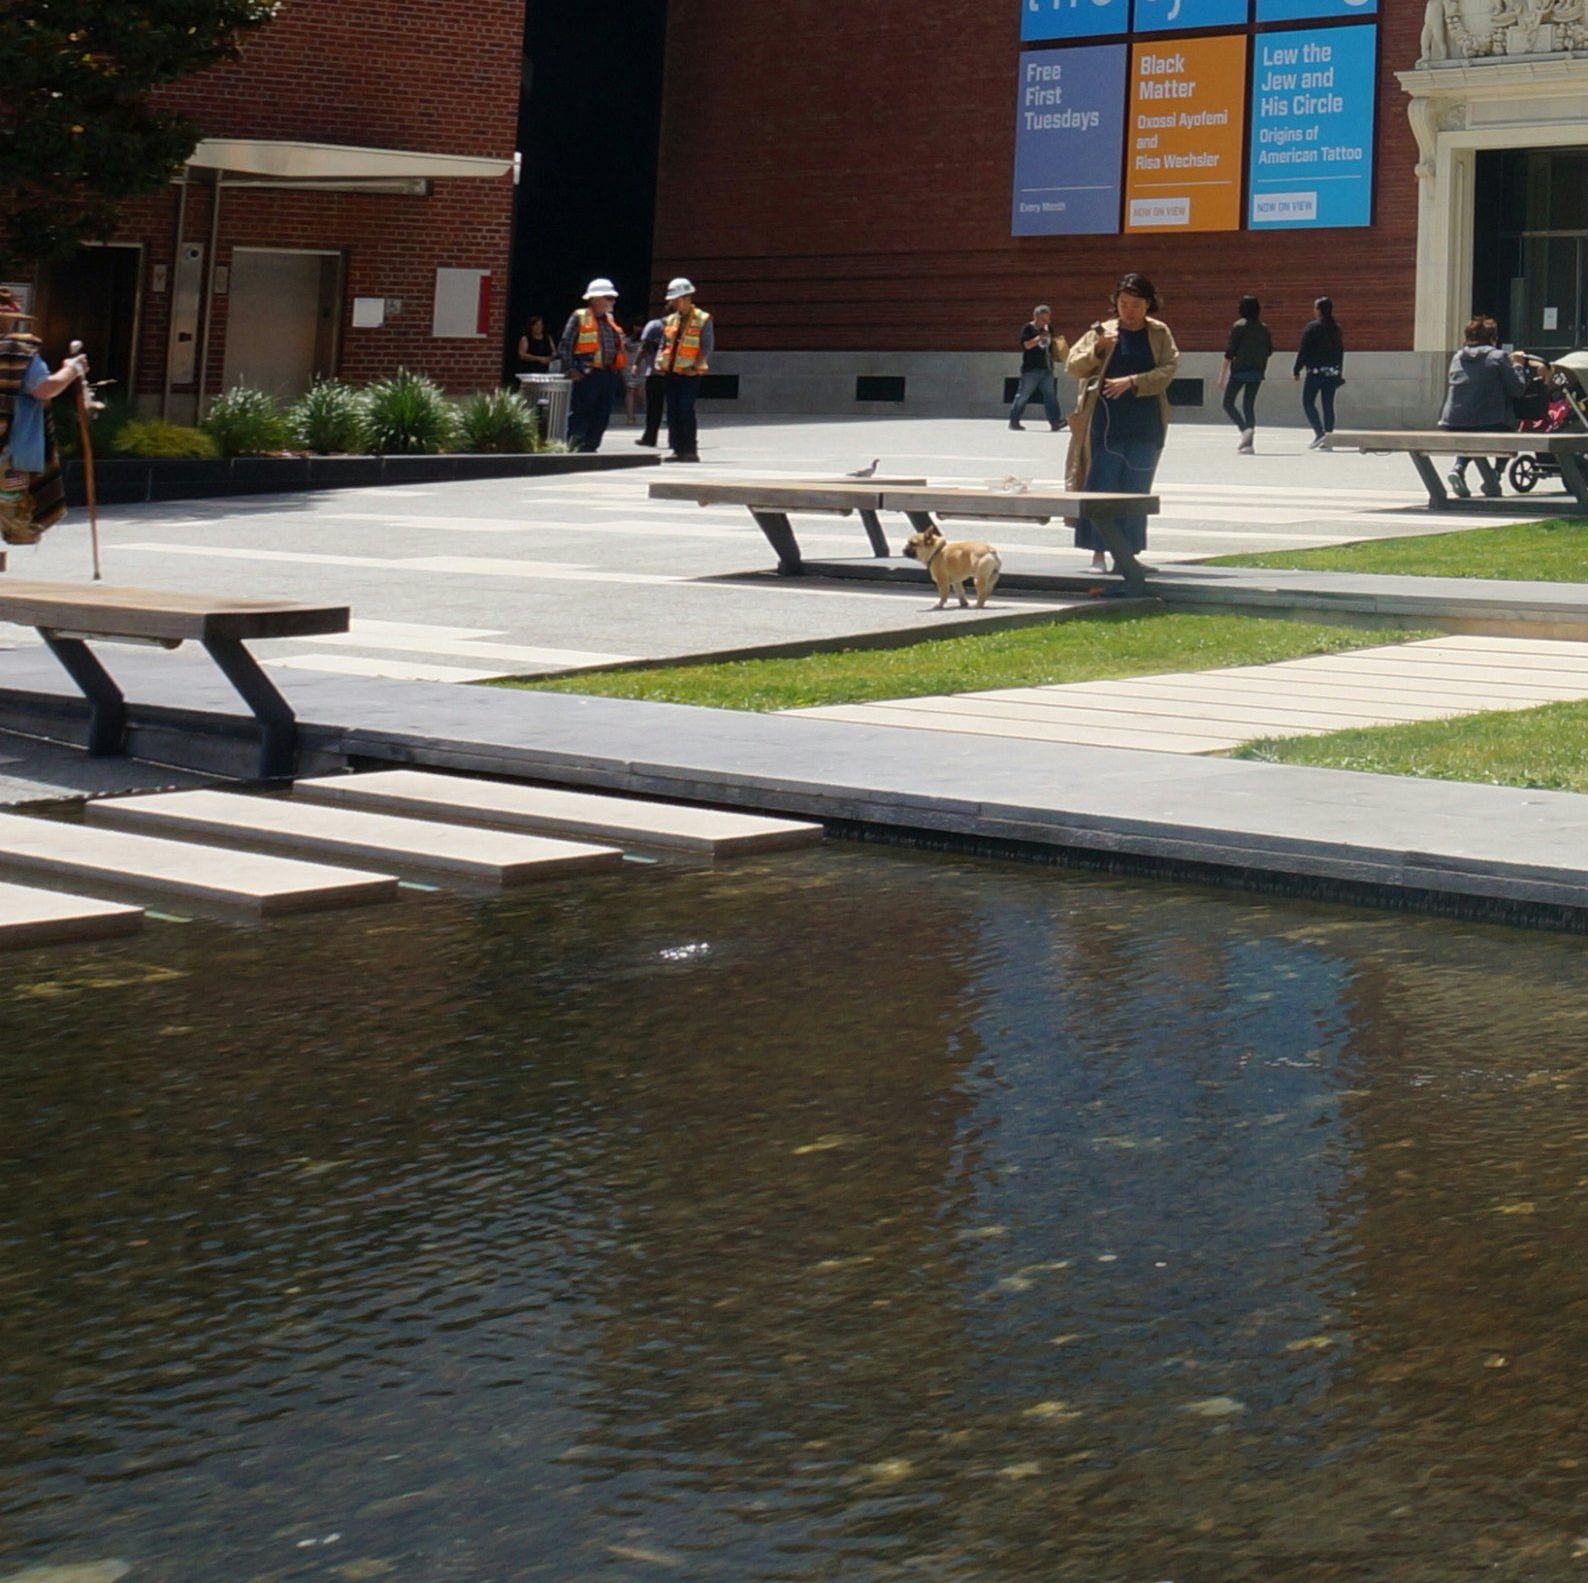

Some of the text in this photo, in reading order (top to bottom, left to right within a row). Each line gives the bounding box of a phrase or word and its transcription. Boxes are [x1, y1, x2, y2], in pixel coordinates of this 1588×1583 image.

[1140, 53, 1185, 75] Black
[1263, 42, 1332, 66] Lew the
[1026, 62, 1061, 83] Free
[1261, 66, 1334, 91] Jew and
[1025, 85, 1062, 106] First
[1139, 78, 1196, 101] Matter
[1260, 92, 1343, 117] His Circle
[1024, 108, 1100, 132] Tuesdays
[1179, 108, 1228, 129] Ayofemi
[1136, 134, 1158, 150] and
[1259, 125, 1320, 146] Origins of
[1135, 152, 1219, 170] Risa Wechsler
[1258, 146, 1362, 164] American Tattoo
[1256, 199, 1313, 213] NOW ON VIEW
